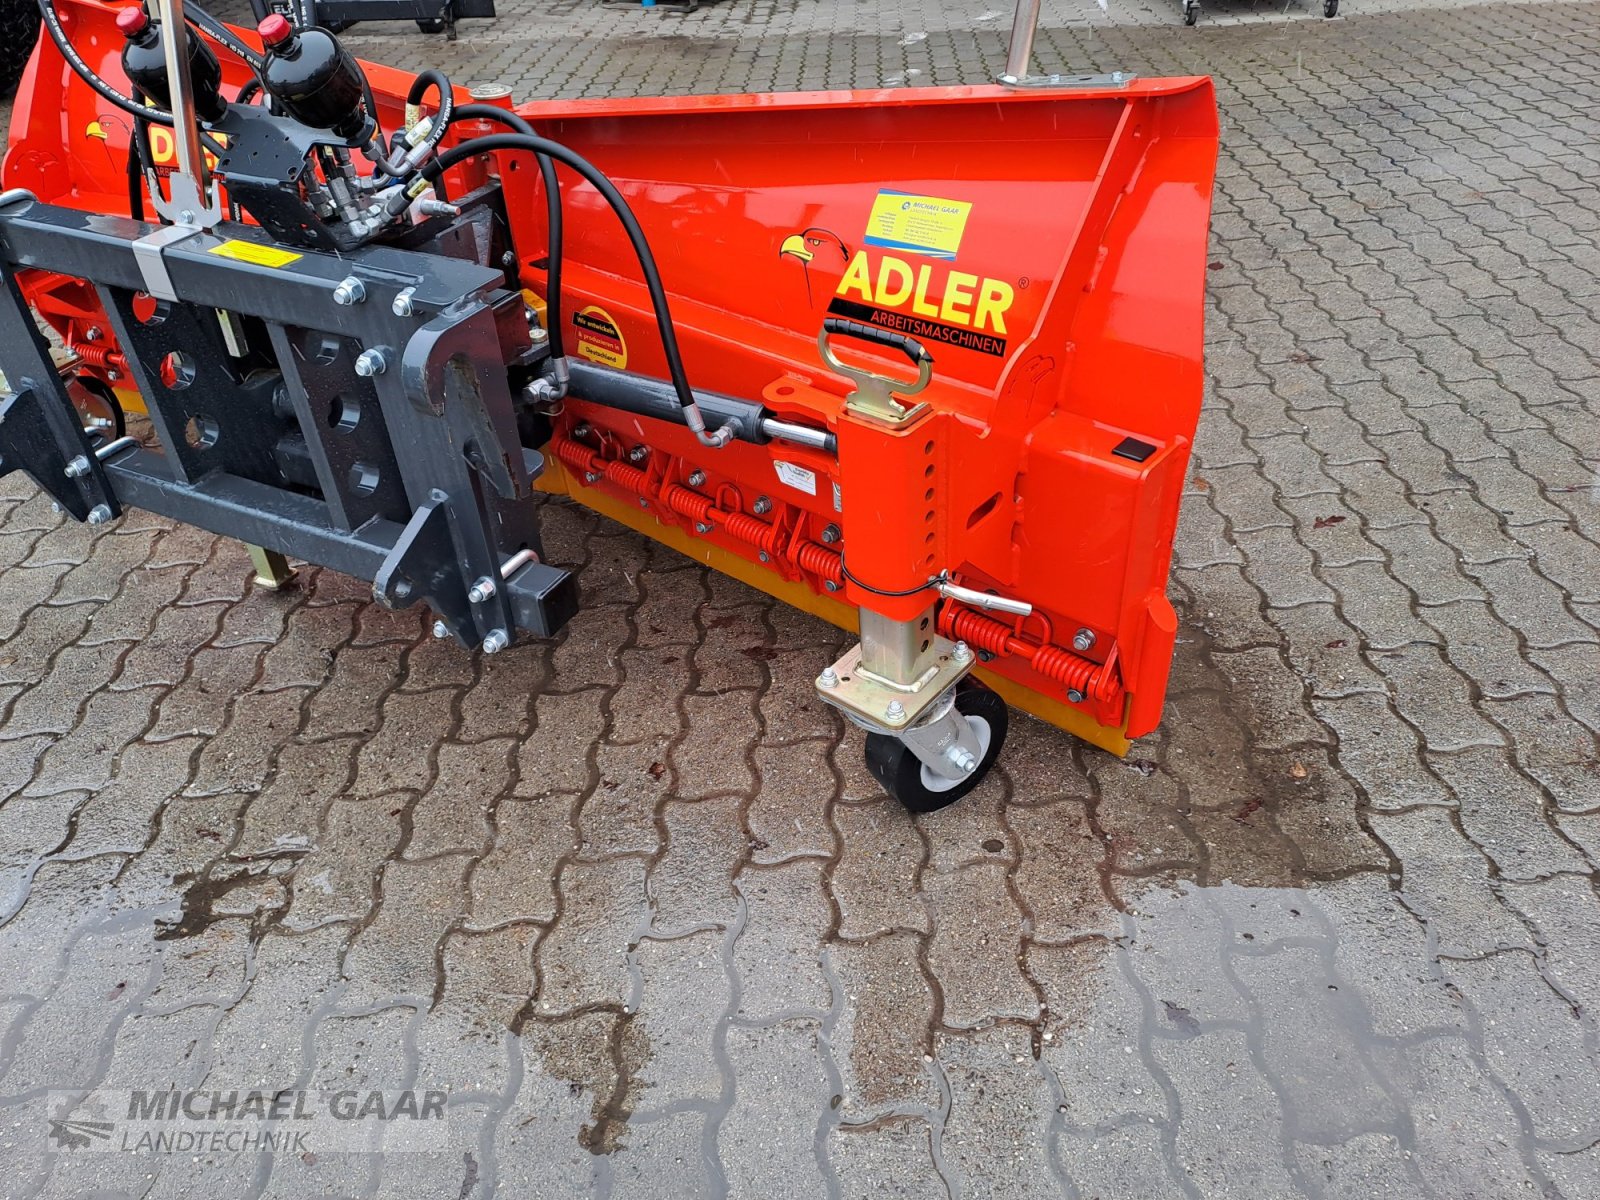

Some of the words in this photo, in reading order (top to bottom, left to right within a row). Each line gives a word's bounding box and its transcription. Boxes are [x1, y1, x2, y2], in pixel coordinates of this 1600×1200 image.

[198, 22, 228, 46] HANSA-FLEX
[433, 97, 452, 140] HANSA-FLEX
[912, 202, 940, 212] MICHAEL
[941, 206, 960, 215] GAAR
[836, 250, 1015, 335] ADLER
[577, 316, 586, 324] Wir
[588, 321, 615, 335] entwickeln
[869, 309, 1004, 354] ARBEITSMASCHINEN
[583, 334, 614, 349] produzieren
[585, 346, 617, 362] Deutschland
